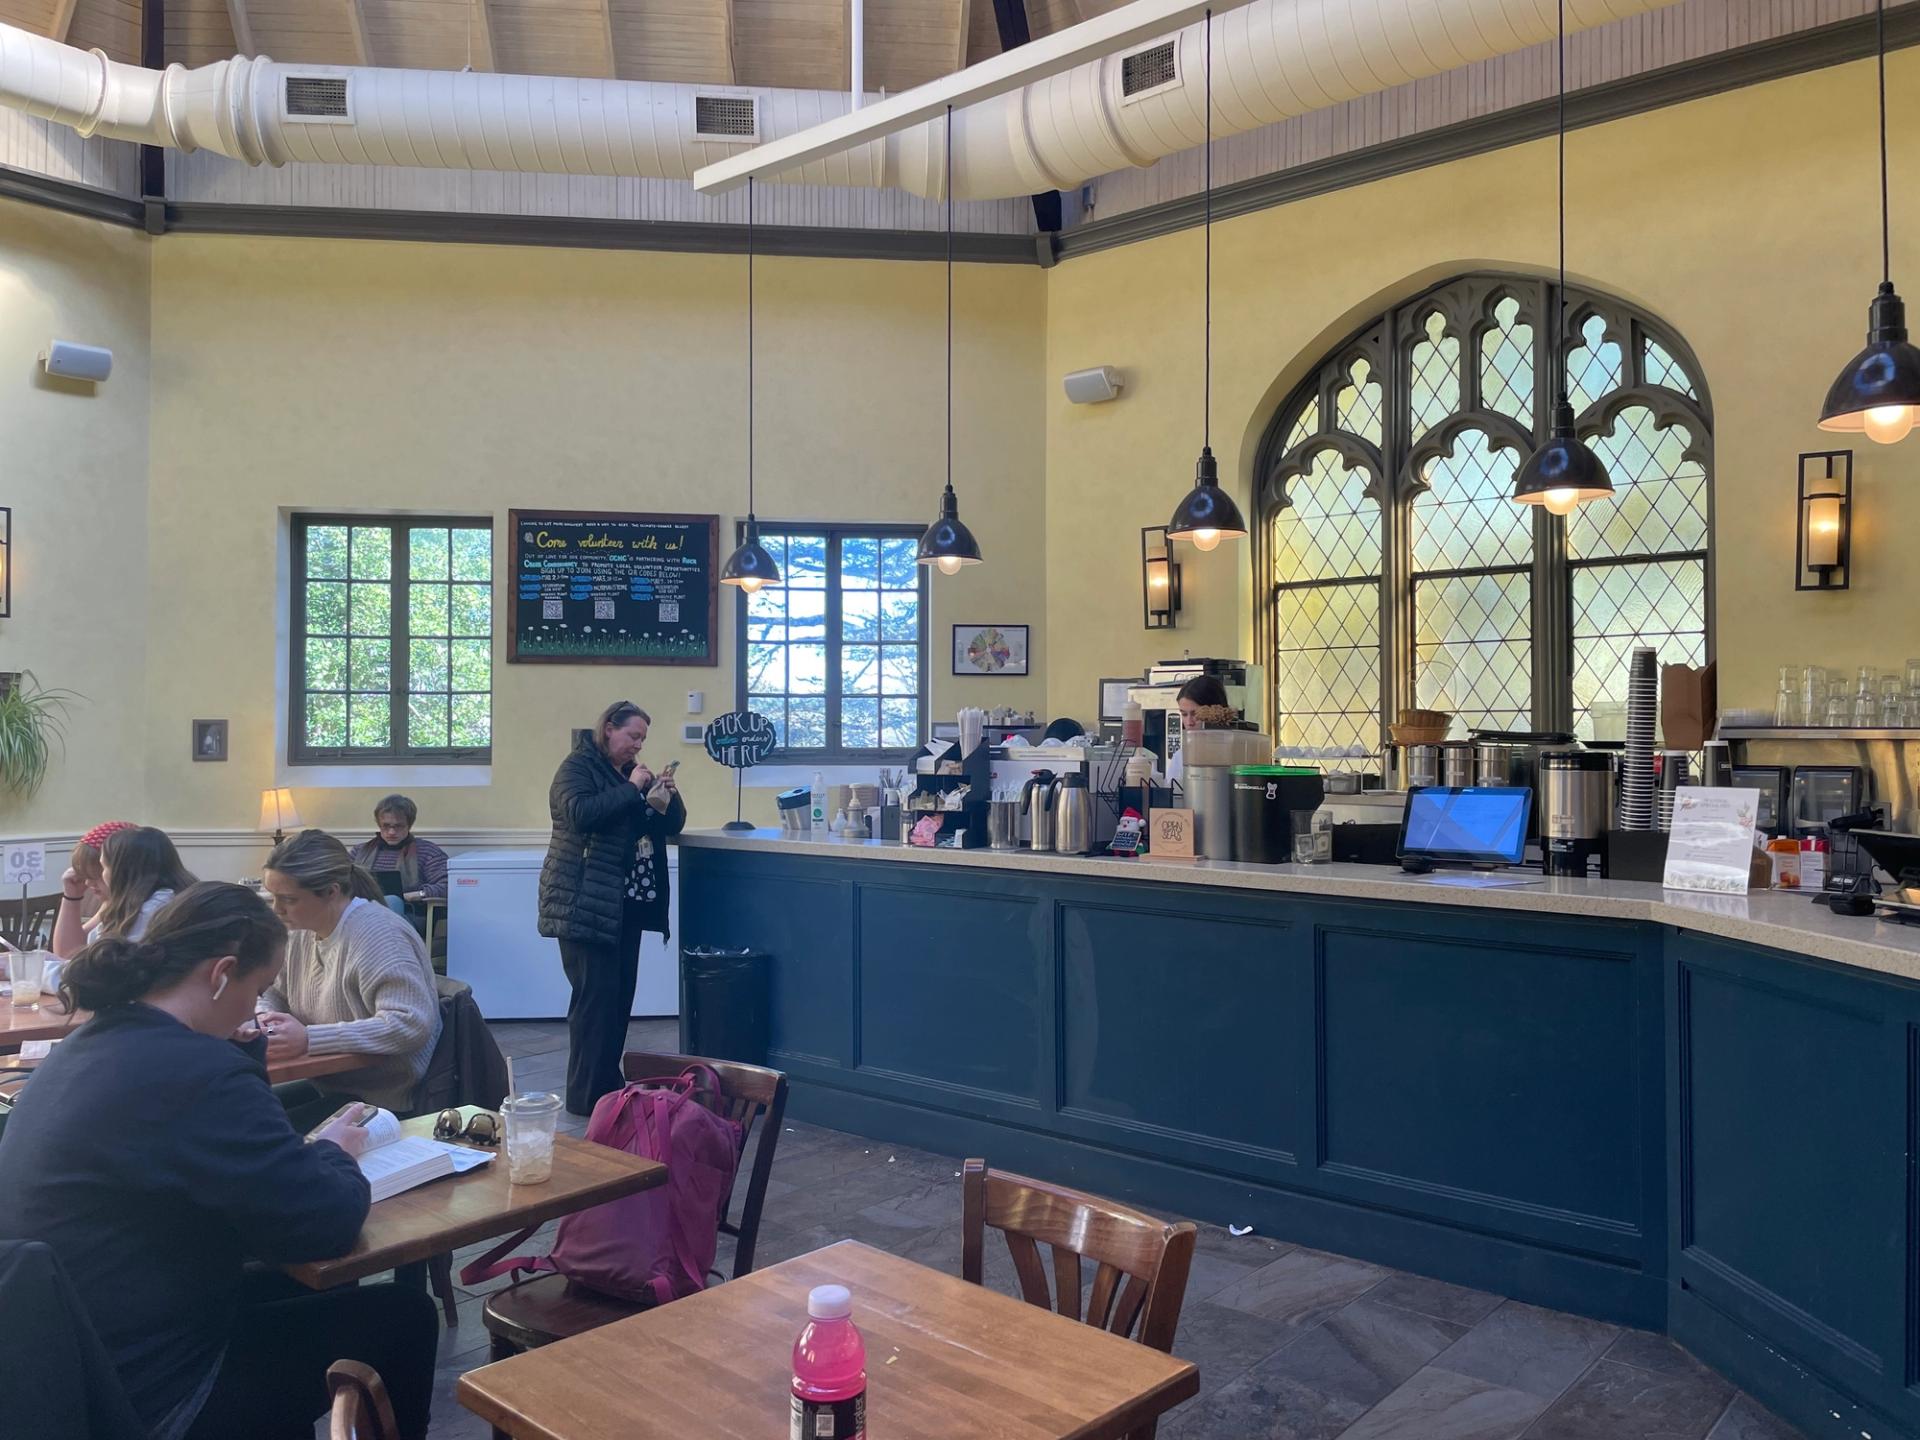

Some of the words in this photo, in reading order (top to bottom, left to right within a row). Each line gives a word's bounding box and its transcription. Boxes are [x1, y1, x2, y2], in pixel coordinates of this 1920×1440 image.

[536, 531, 568, 548] Come
[578, 532, 624, 549] volunteer
[632, 535, 657, 550] with
[665, 535, 684, 550] us!
[712, 712, 749, 736] PICK
[750, 714, 768, 732] UP
[742, 734, 769, 742] orders
[721, 745, 760, 766] HERE
[1162, 820, 1183, 832] OPEN
